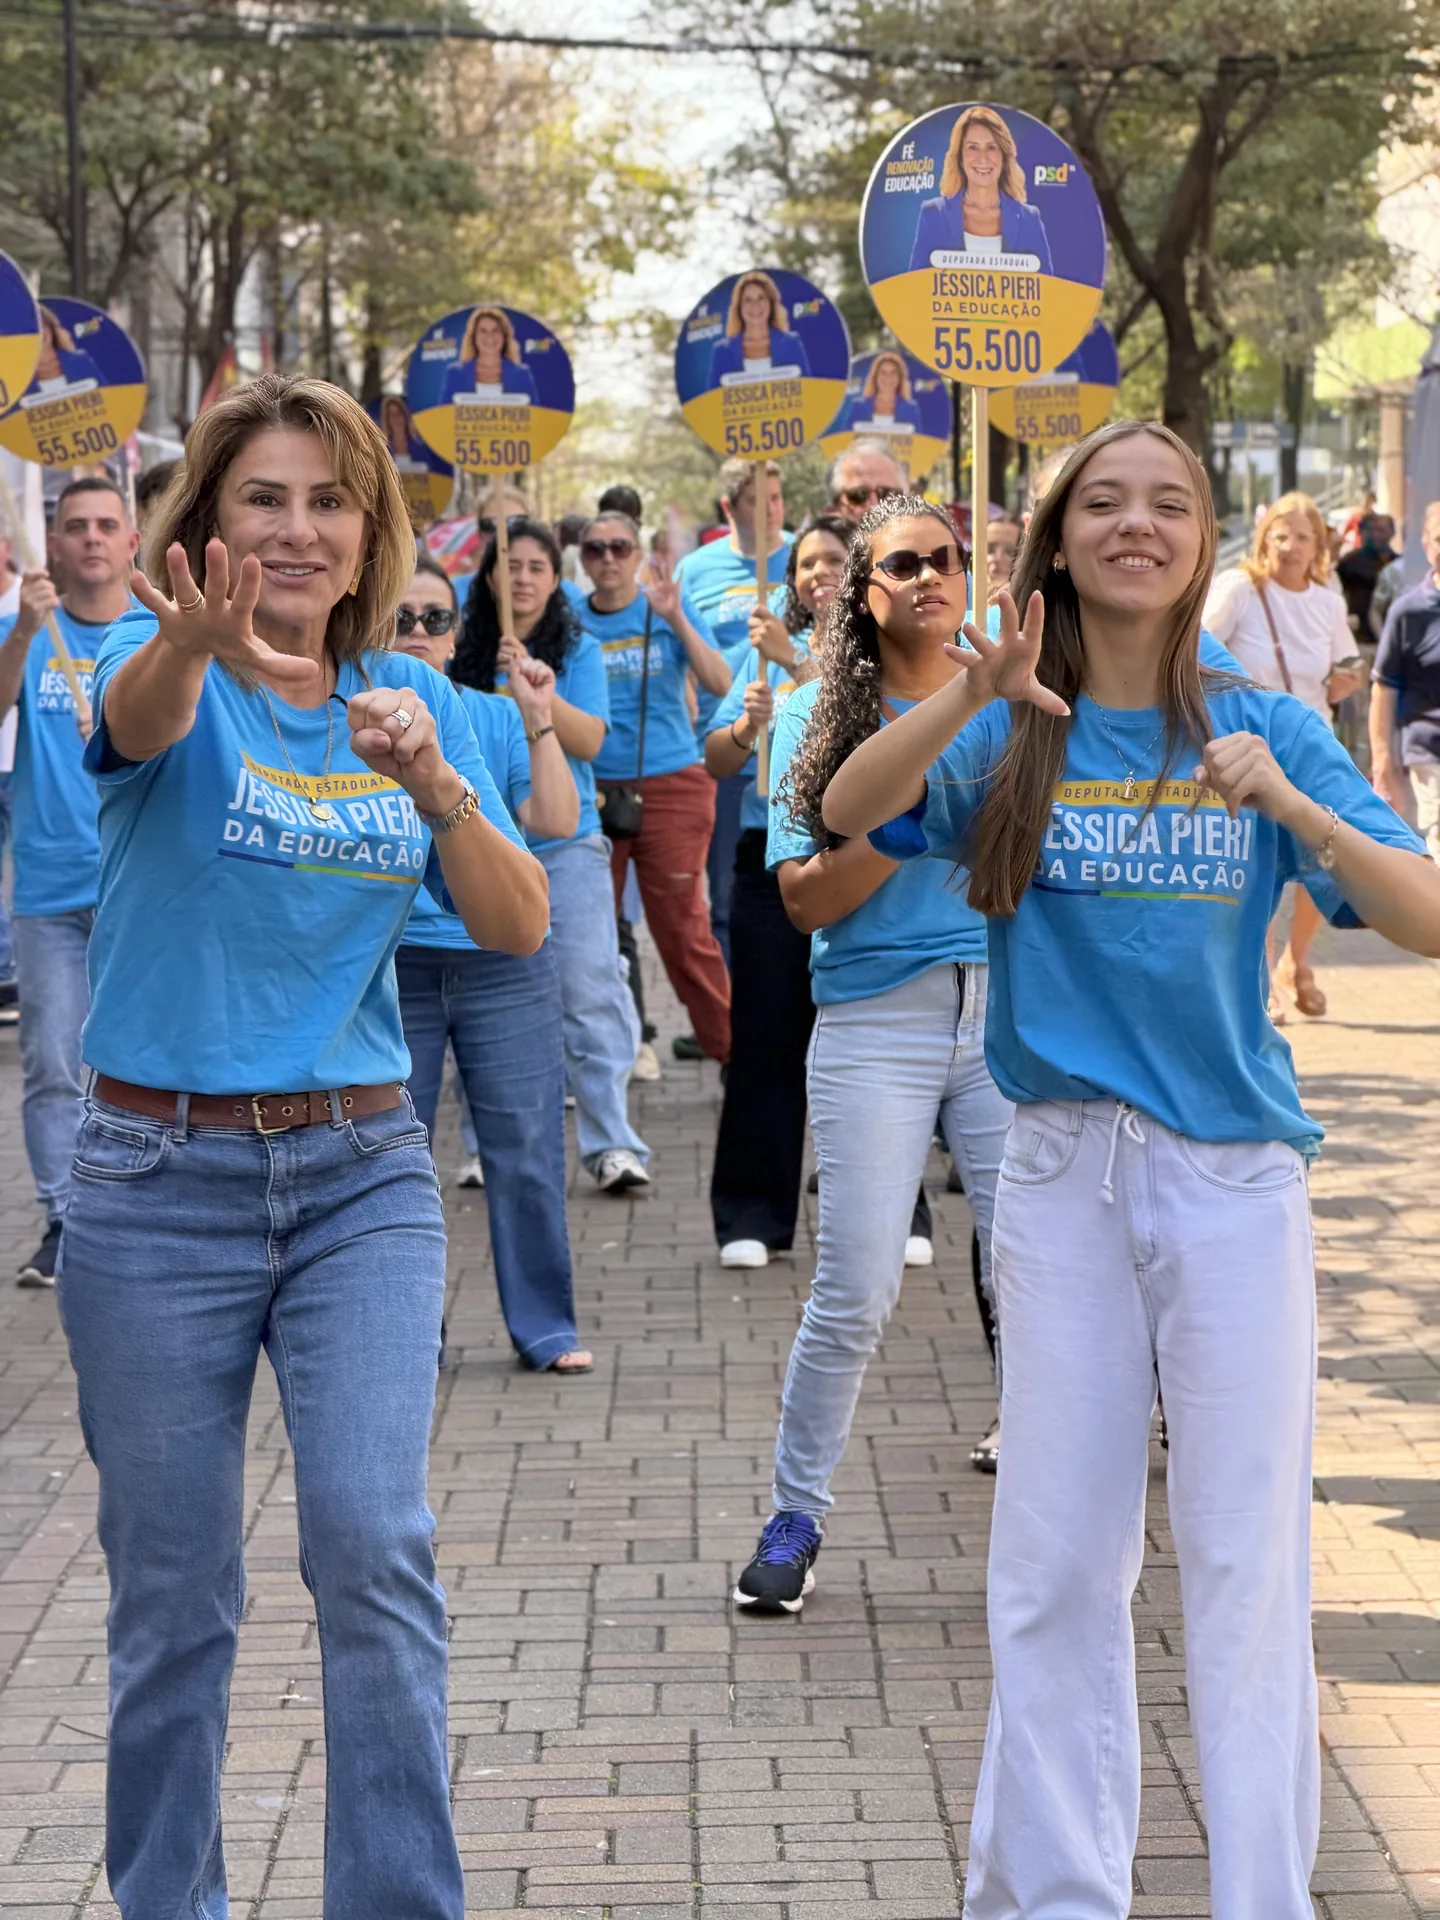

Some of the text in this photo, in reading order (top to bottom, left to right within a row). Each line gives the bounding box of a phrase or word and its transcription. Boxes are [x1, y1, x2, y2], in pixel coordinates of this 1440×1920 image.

[902, 141, 915, 160] FÉ
[886, 156, 934, 176] RENOVAÇÃO
[1034, 162, 1068, 187] psd
[884, 173, 935, 194] EDUCAÇÃO
[942, 254, 1030, 268] DEPUTADA ESTADUAL
[932, 268, 1041, 301] JÉSSICA PIERI
[932, 301, 1041, 319] DA EDUCAÇÃO
[934, 326, 1042, 374] 55.500
[725, 417, 804, 456] 55.500
[1015, 413, 1081, 440] 55.500
[37, 422, 118, 466] 55.500
[455, 439, 531, 466] 55.500
[316, 775, 386, 793] ESTADUAL
[1064, 786, 1139, 799] DEPUTAA
[223, 818, 424, 870] DA EDUCAÇÃO
[1044, 801, 1252, 861] ÉSSICA PIERI
[1081, 860, 1246, 890] EDUCAÇÃO
